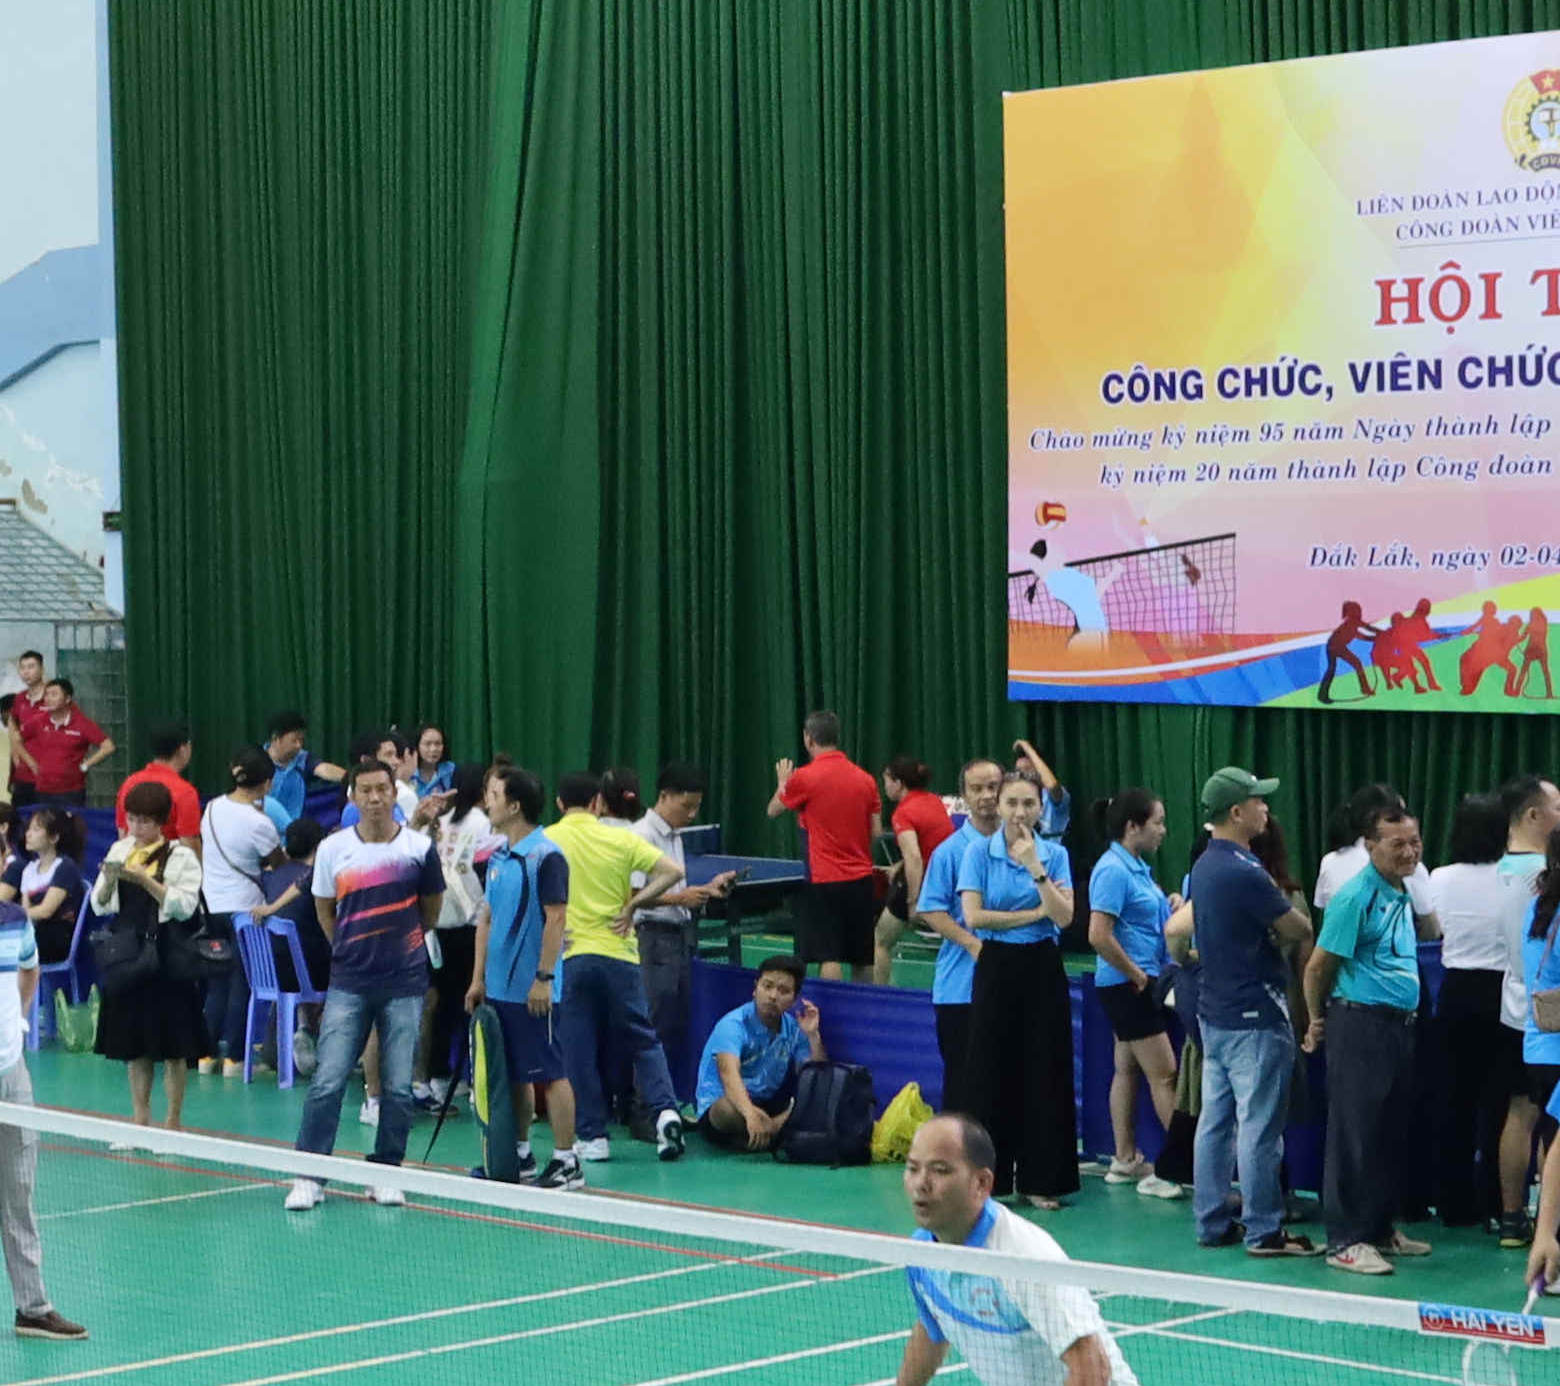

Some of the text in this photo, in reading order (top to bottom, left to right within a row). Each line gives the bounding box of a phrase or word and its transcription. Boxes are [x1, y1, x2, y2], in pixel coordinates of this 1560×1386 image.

[1357, 194, 1405, 216] LIÊN
[1477, 187, 1518, 206] LAO
[1396, 217, 1453, 241] CÔNG
[1374, 260, 1503, 335] HỘI
[1102, 365, 1204, 404] CÔNG
[1217, 356, 1334, 401] CHỨC,
[1348, 352, 1442, 392] VIÊN
[1030, 428, 1085, 450] Chào
[1091, 426, 1153, 451] mừng
[1195, 422, 1251, 447] niệm
[1260, 422, 1284, 442] 95
[1293, 421, 1345, 441] năm
[1353, 418, 1415, 443] Ngày
[1425, 413, 1498, 437] thành
[1510, 413, 1551, 438] lập
[1133, 463, 1187, 487] niệm
[1196, 463, 1220, 482] 20
[1228, 461, 1278, 481] năm
[1287, 459, 1357, 481] thành
[1368, 458, 1406, 482] lập
[1417, 455, 1480, 482] Công
[1489, 453, 1552, 476] đoàn
[1308, 542, 1357, 568] Đắk
[1366, 540, 1421, 570] Lắk,
[1431, 545, 1491, 572] ngày
[1451, 1309, 1488, 1332] HAI
[1491, 1314, 1535, 1338] YEN
